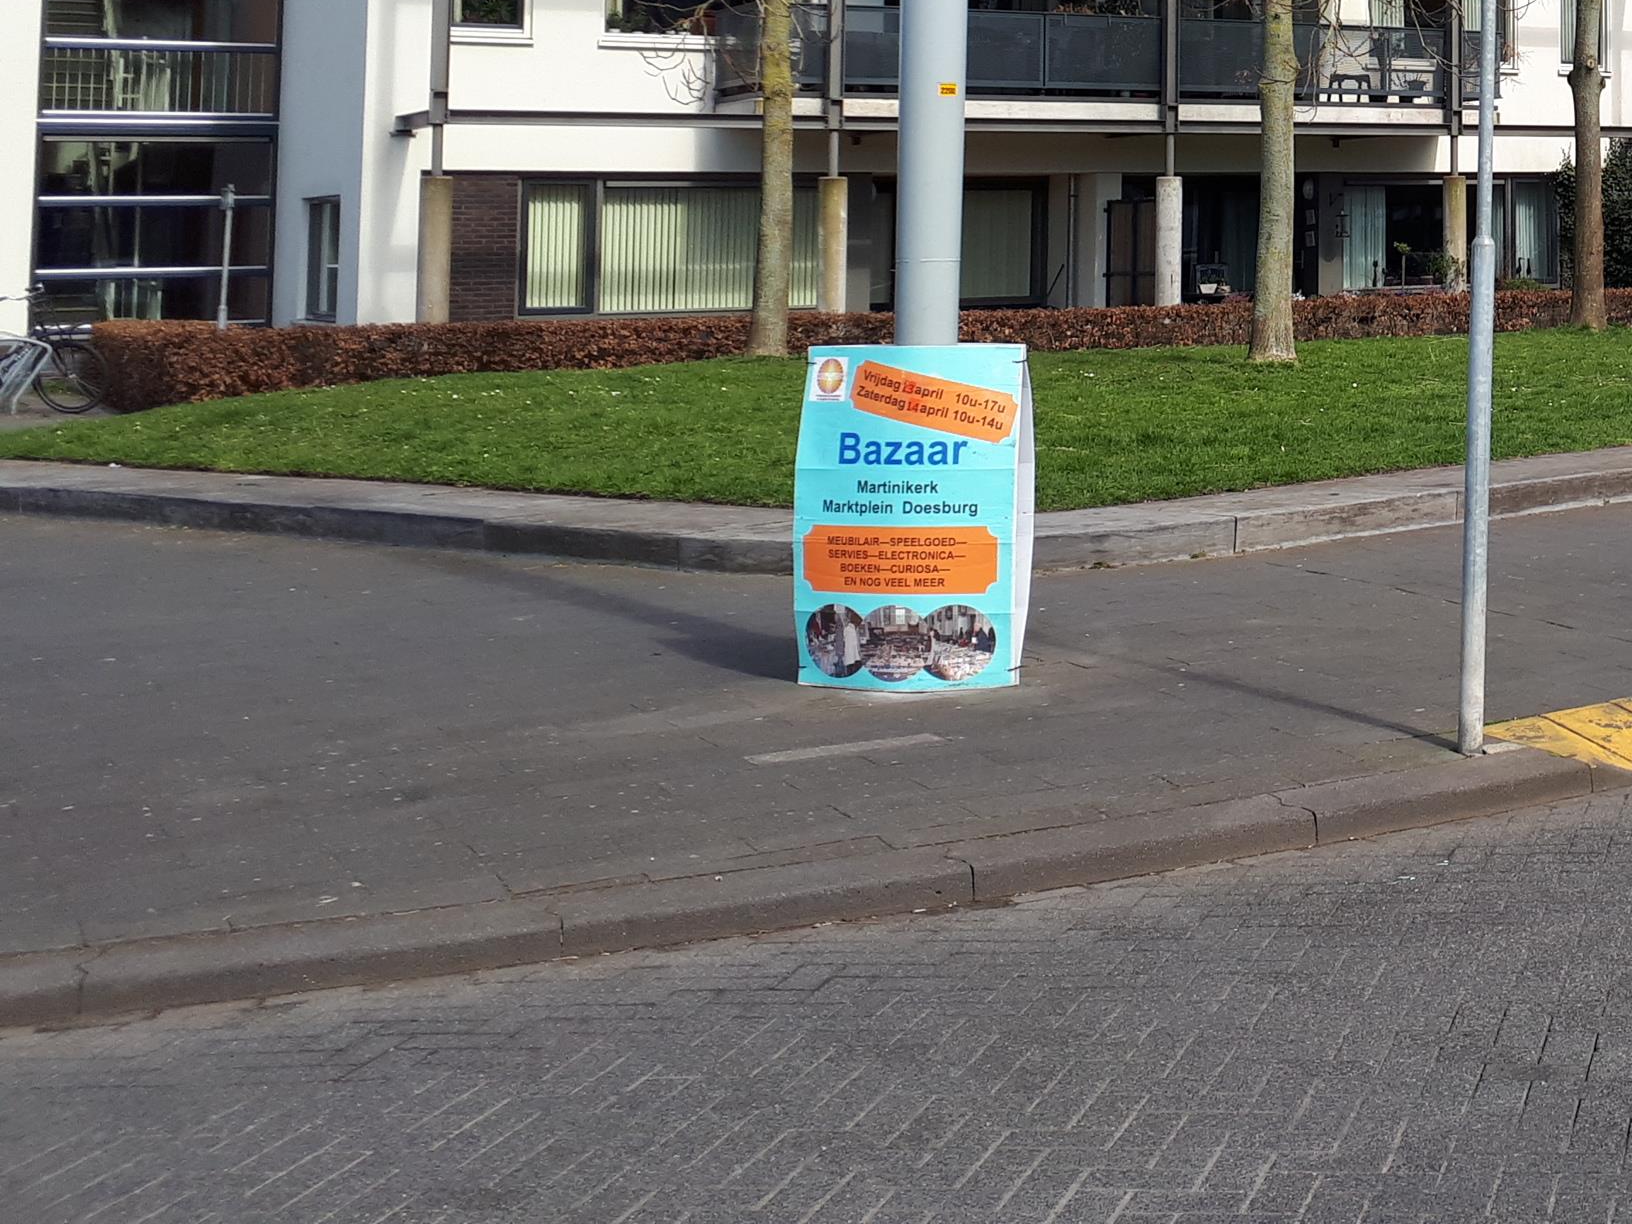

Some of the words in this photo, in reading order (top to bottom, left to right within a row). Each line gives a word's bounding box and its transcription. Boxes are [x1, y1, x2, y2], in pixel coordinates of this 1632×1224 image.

[864, 369, 901, 393] Vrijdag
[914, 386, 944, 400] april
[955, 393, 1006, 414] 10u-17u
[857, 386, 906, 411] Zaterdag
[920, 404, 949, 418] april
[953, 410, 1004, 430] 10u-14u
[838, 432, 968, 466] Bazaar
[857, 480, 938, 495] Martinikerk
[822, 499, 893, 515] Marktplein
[902, 501, 978, 517] Doesburg
[844, 577, 857, 587] EN
[859, 577, 881, 587] NOG
[884, 577, 910, 587] VEEL
[914, 577, 945, 588] MEER
